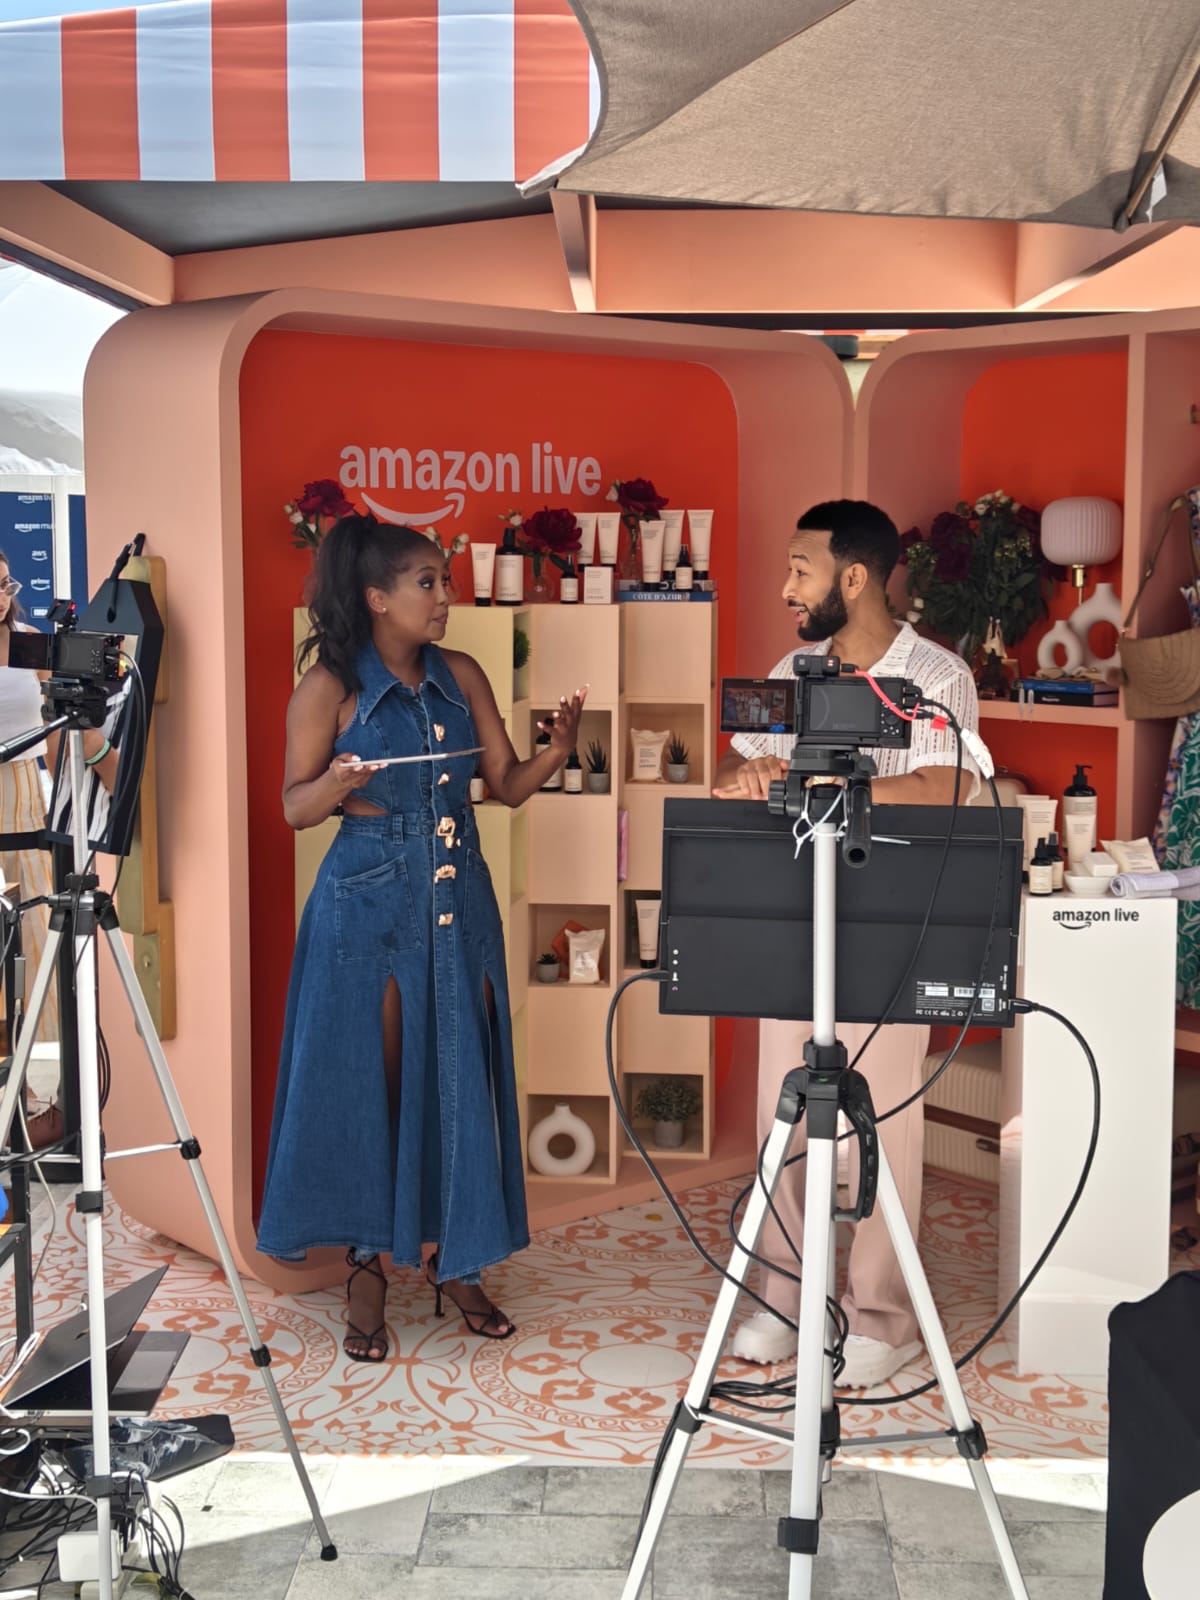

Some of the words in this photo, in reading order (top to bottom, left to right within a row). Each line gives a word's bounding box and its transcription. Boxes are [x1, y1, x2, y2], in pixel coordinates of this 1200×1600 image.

[339, 445, 520, 493] amazon
[531, 441, 601, 496] live
[1052, 910, 1110, 922] amazon
[1114, 908, 1140, 922] live
